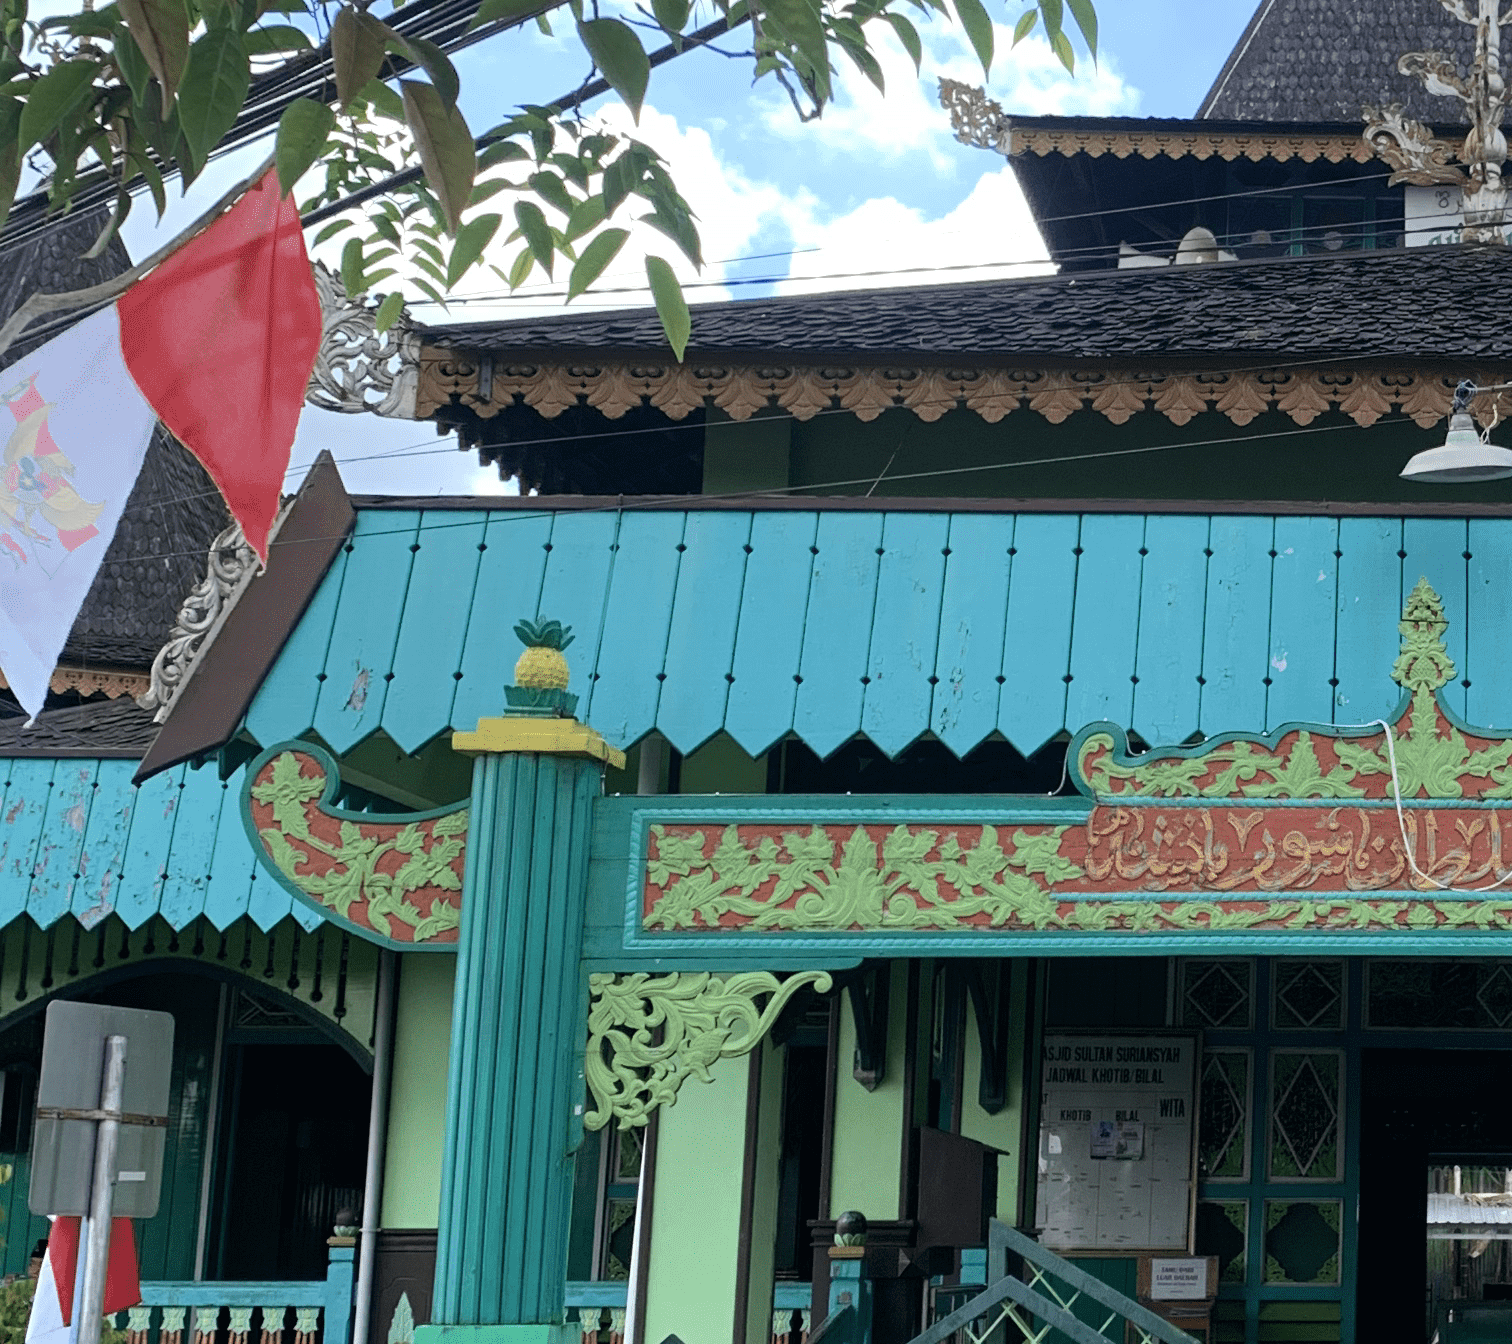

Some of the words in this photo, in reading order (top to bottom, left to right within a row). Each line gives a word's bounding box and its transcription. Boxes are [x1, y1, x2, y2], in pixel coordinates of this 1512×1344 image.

[1042, 1046, 1071, 1061] ASJID
[1074, 1046, 1113, 1062] SULTAN
[1116, 1047, 1181, 1063] SURIANSYAH
[1046, 1067, 1087, 1083] JADWAL
[1092, 1068, 1164, 1084] KHOTIB/BILAL
[1060, 1109, 1092, 1121] KHOTIB
[1116, 1110, 1140, 1122] BILAL
[1159, 1098, 1185, 1118] WITA
